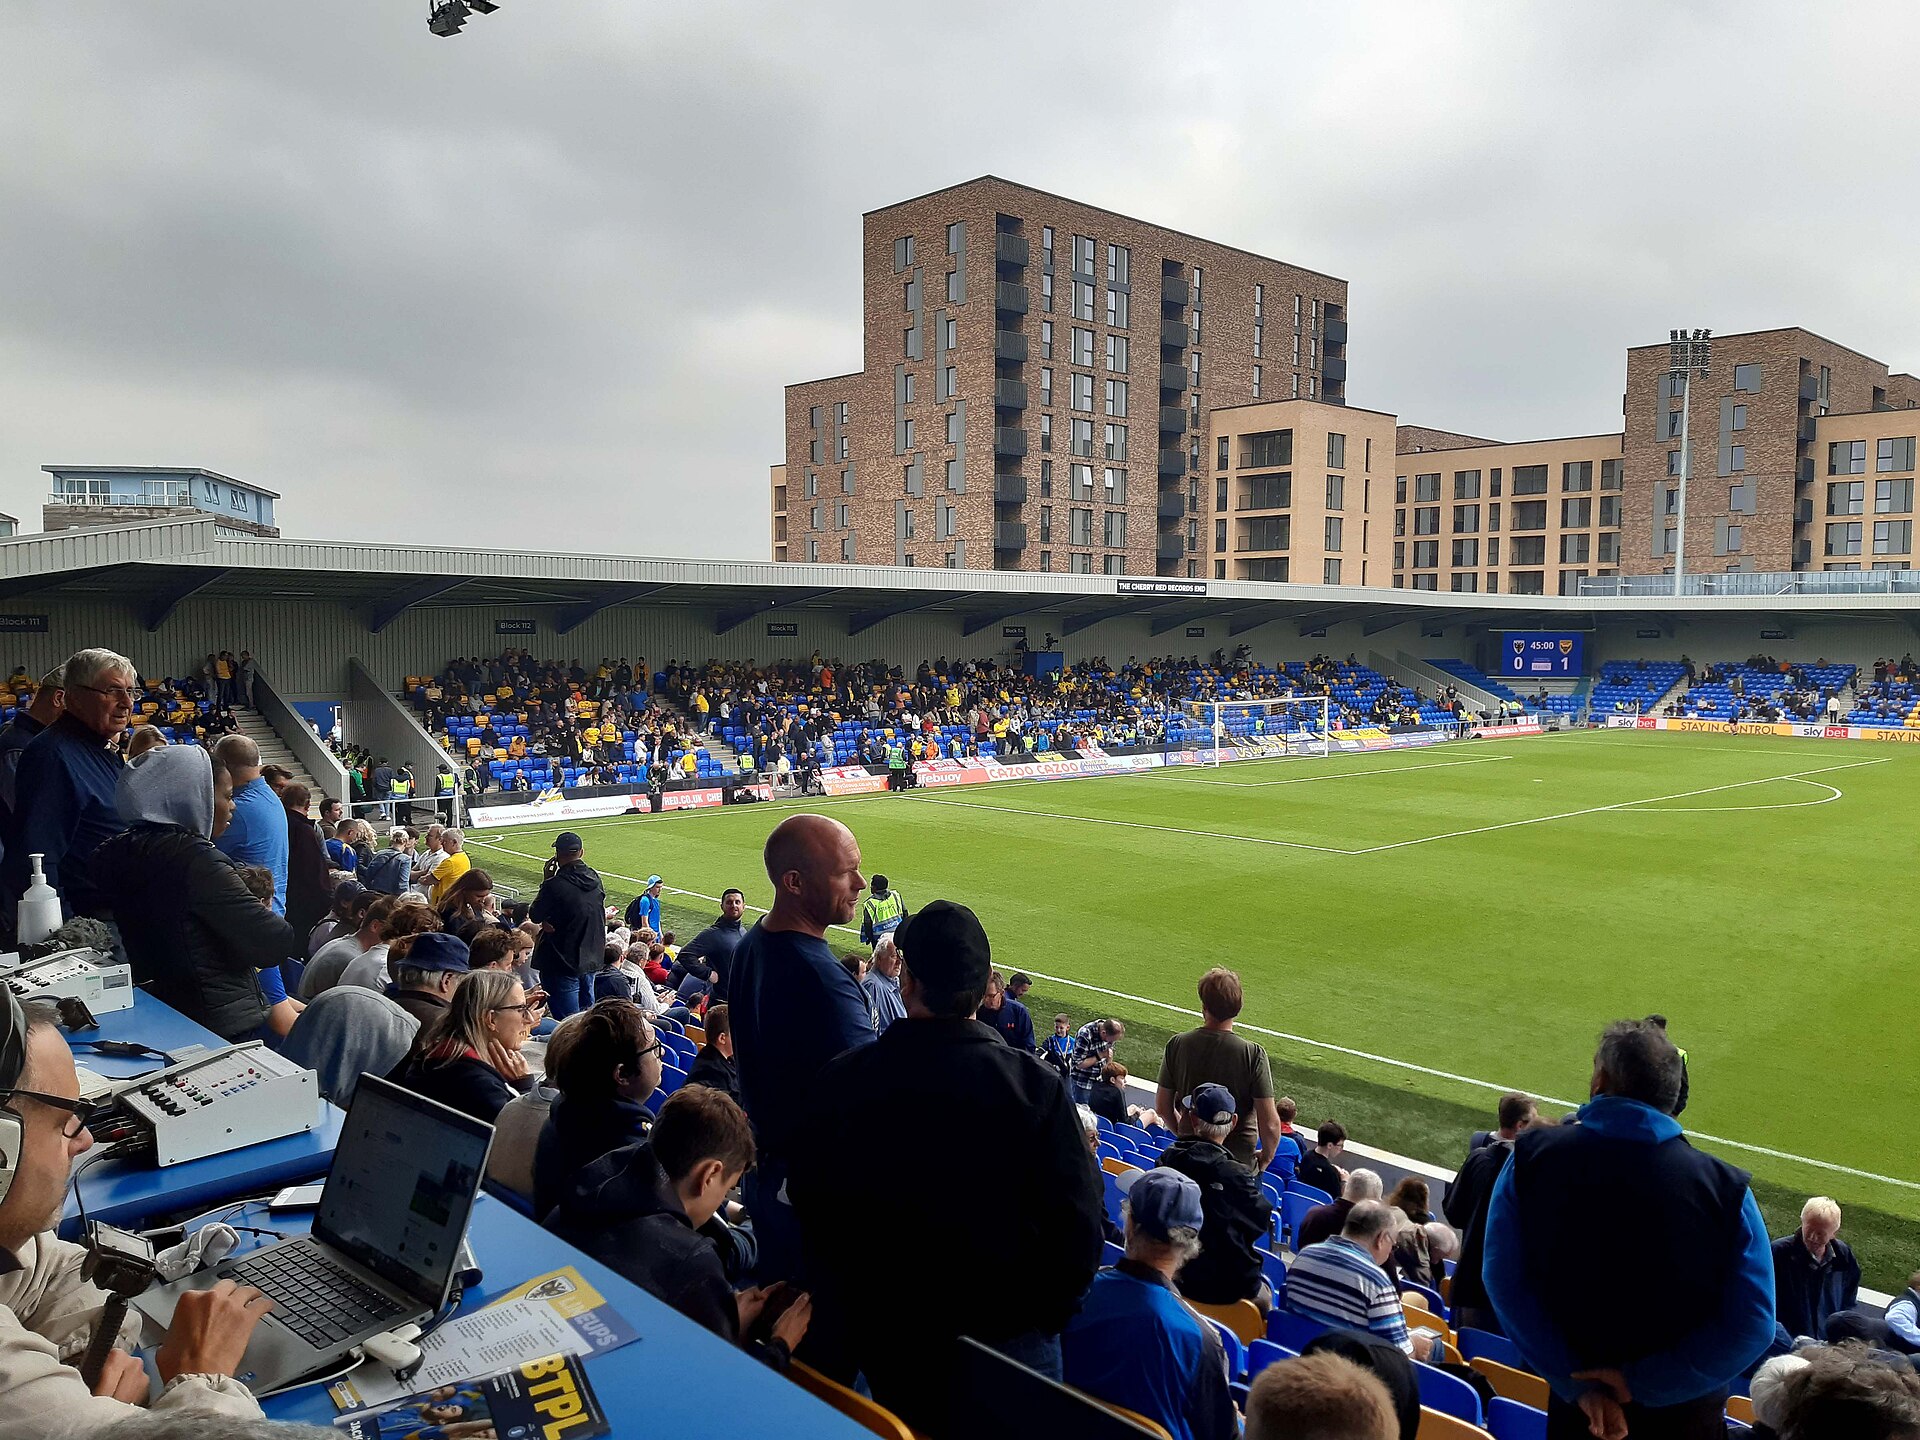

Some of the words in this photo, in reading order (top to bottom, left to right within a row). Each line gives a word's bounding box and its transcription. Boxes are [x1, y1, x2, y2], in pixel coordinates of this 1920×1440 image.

[1131, 583, 1155, 591] CHERRY
[1167, 584, 1194, 592] RECORDS
[1530, 641, 1554, 650] 45:00
[1513, 656, 1523, 670] 0
[1561, 657, 1569, 671] 1
[1617, 717, 1635, 728] sky
[1637, 717, 1656, 729] bet
[1681, 721, 1706, 732] STAY
[1707, 723, 1720, 732] IN
[1803, 727, 1823, 737] sky
[1826, 728, 1847, 738] bet
[1877, 731, 1905, 741] STAY
[989, 764, 1034, 779] CAZOO
[1036, 762, 1079, 775] CAZOO
[519, 1353, 589, 1440] BTPL
